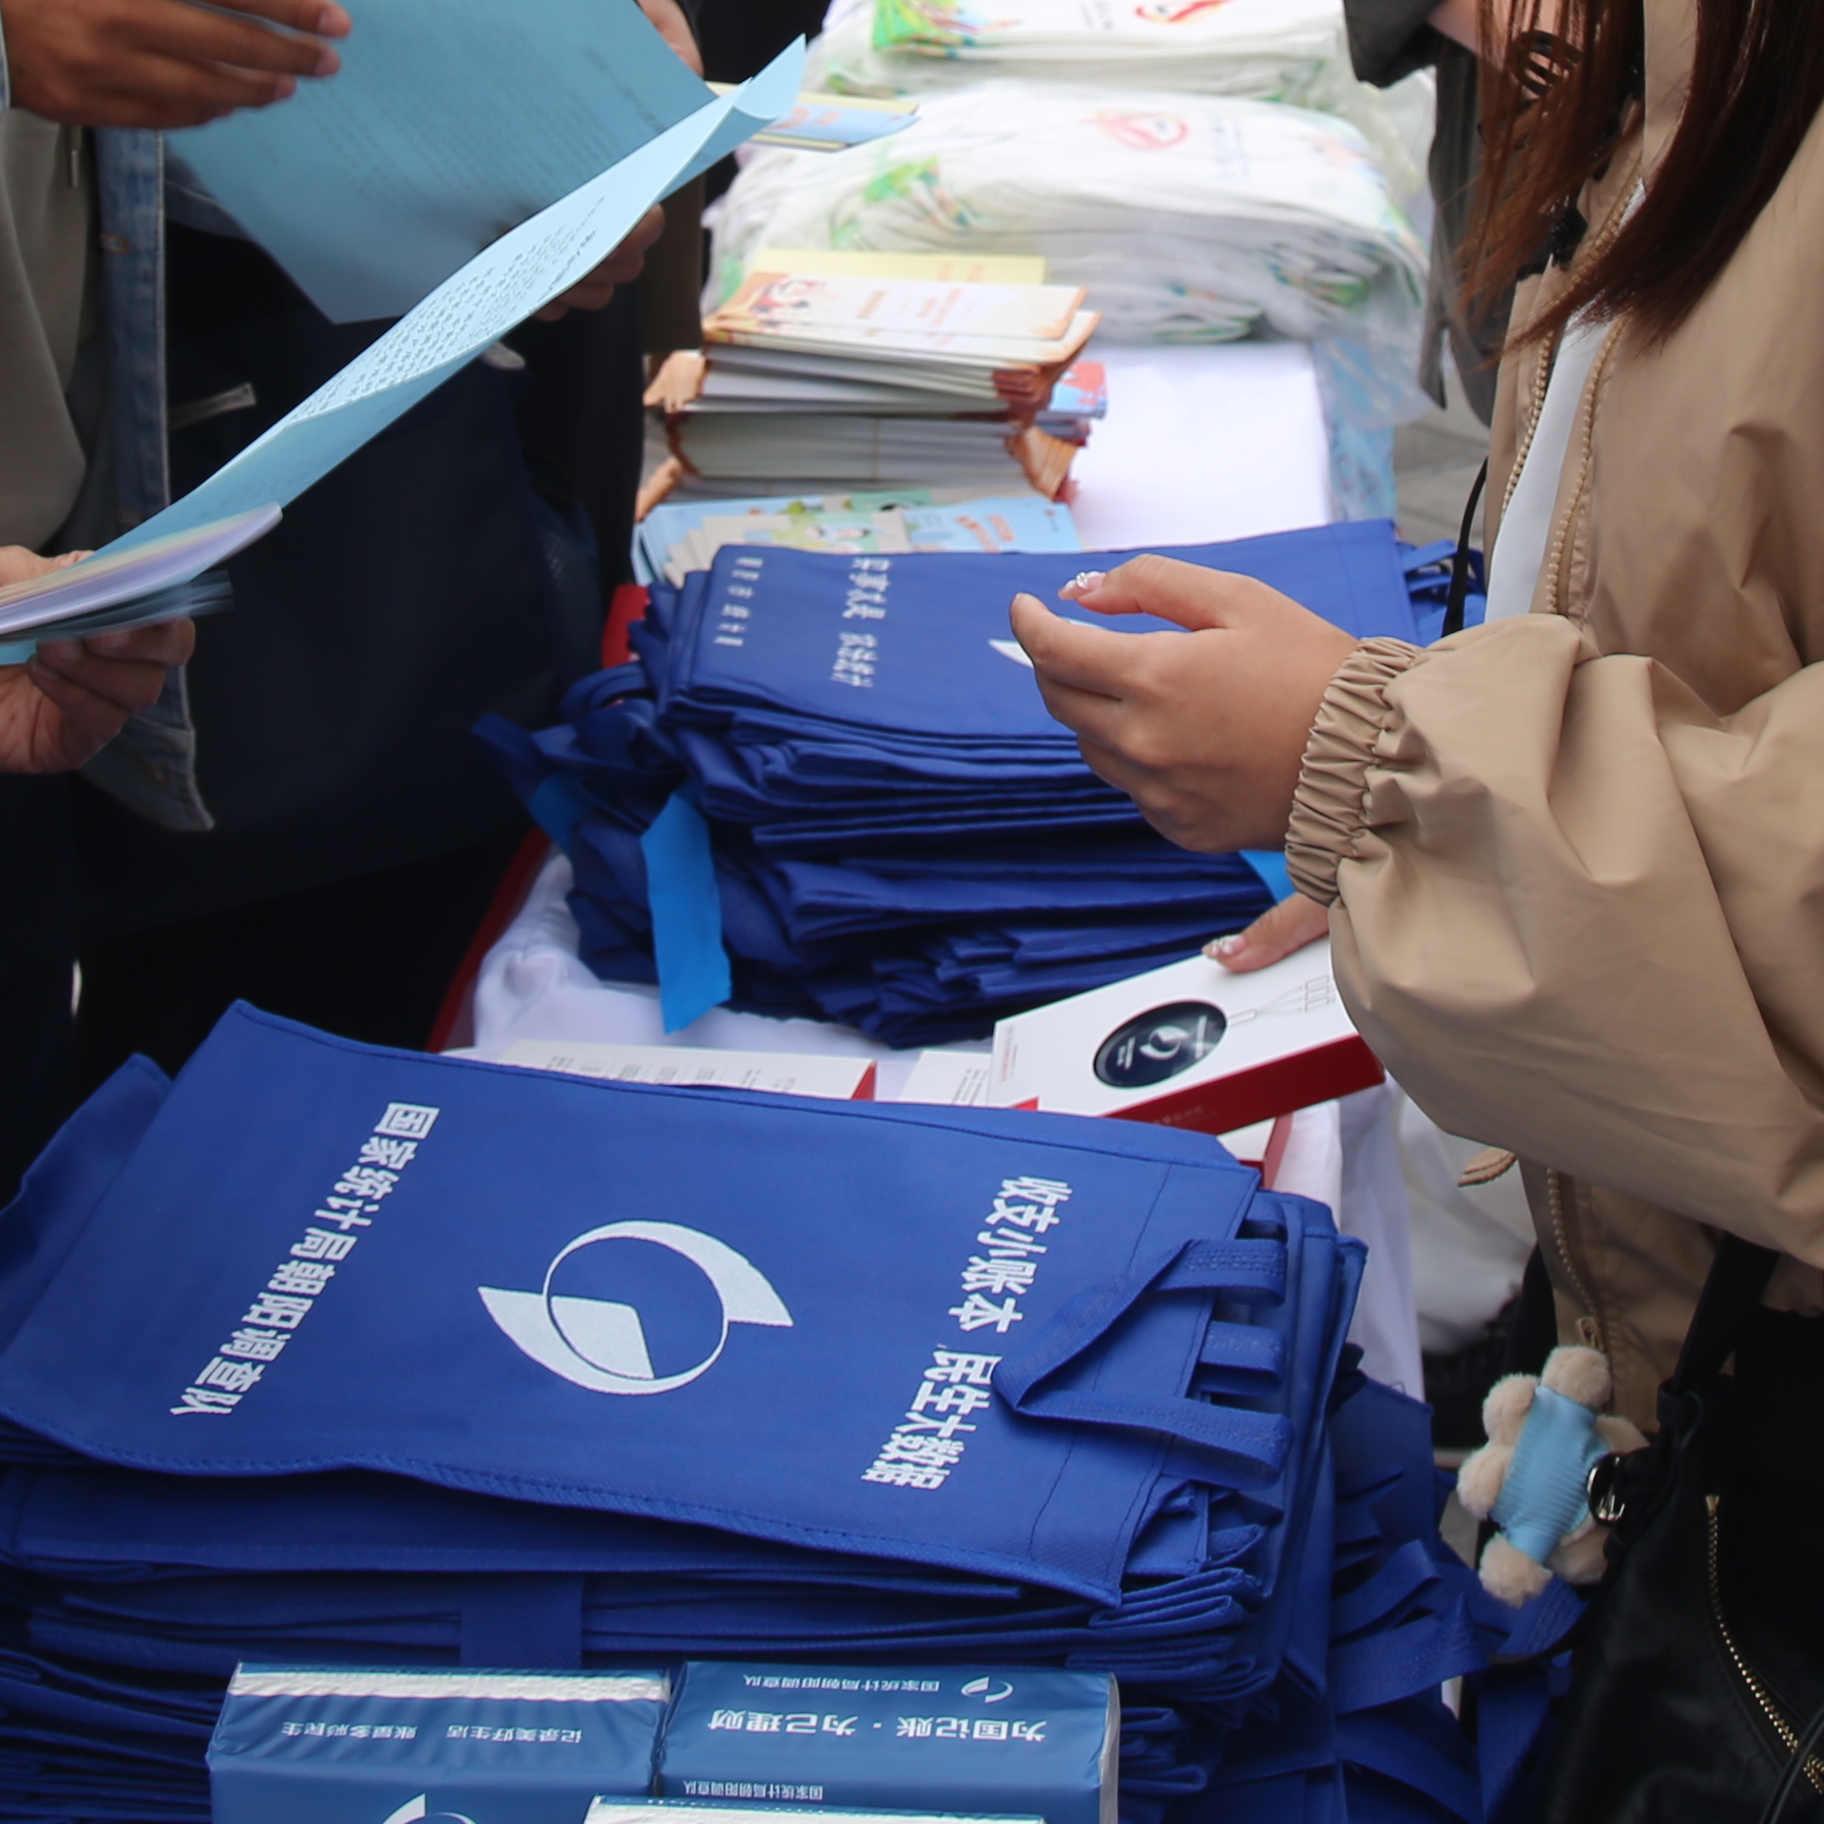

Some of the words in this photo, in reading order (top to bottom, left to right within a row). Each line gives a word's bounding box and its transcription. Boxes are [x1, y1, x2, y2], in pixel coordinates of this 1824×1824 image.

[170, 1101, 440, 1416] 国家统计局朝阳调查队
[949, 1175, 1073, 1334] 收支小账本
[861, 1347, 1002, 1490] 民生大数据
[742, 1674, 941, 1693] 国家统计局朝阳调查队
[445, 1723, 583, 1745] 记录美好生活
[682, 1779, 824, 1801] 国家统计局朝阳调查队
